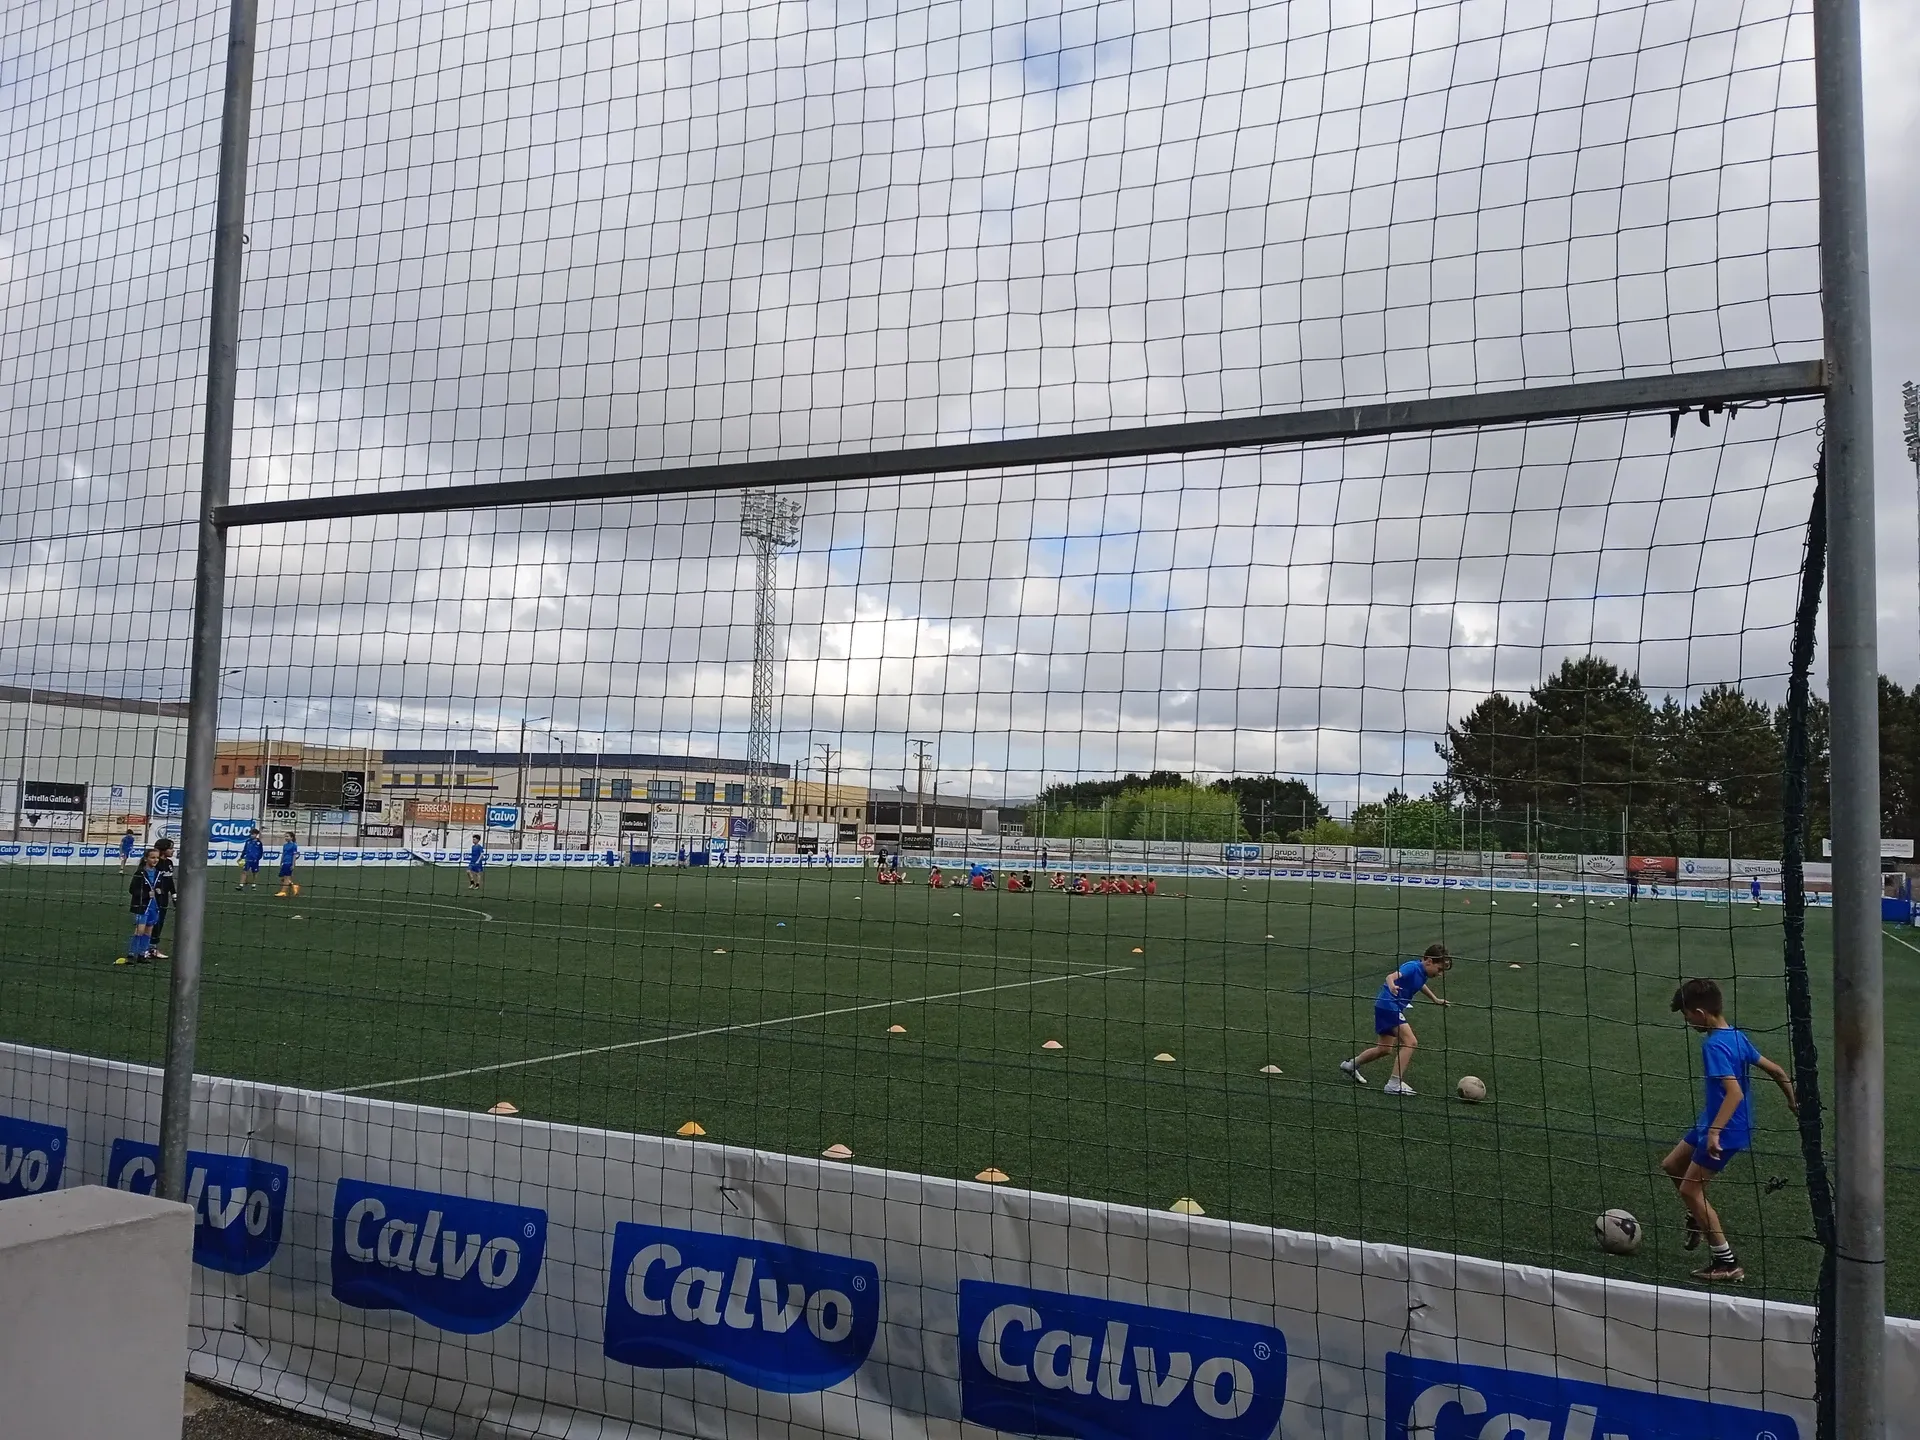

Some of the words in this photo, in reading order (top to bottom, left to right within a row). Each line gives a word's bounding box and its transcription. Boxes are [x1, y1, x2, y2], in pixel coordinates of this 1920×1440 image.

[24, 793, 49, 802] Estrella
[49, 795, 72, 803] Galicia
[272, 810, 296, 818] TODO
[489, 810, 516, 822] Calvo
[211, 822, 251, 836] Calvo
[1744, 866, 1780, 874] gestagua
[117, 1156, 269, 1236] Clvo
[344, 1198, 520, 1289] Calvo
[624, 1243, 853, 1342] Calvo
[978, 1303, 1254, 1419] Calvo
